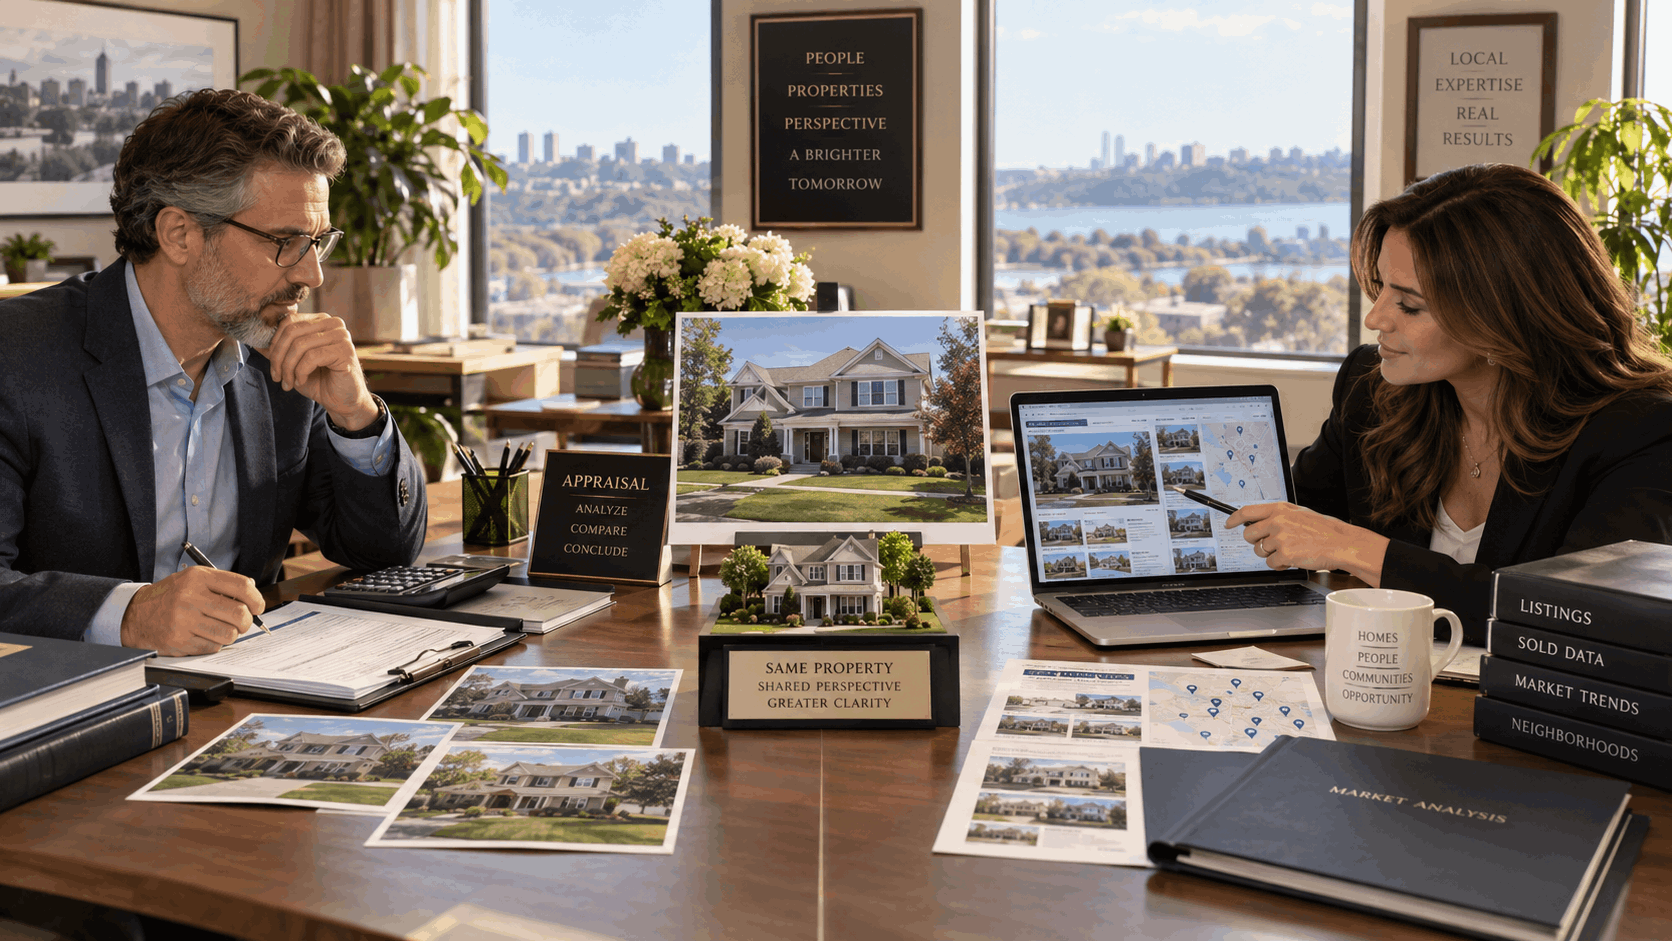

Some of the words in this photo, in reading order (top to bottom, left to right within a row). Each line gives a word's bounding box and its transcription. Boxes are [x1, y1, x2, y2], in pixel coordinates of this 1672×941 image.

[806, 52, 865, 64] PEOPLE
[1451, 52, 1508, 65] LOCAL
[788, 84, 883, 97] PROPERTIES
[1435, 78, 1523, 91] EXPERTISE
[1457, 107, 1499, 120] REAL
[785, 117, 887, 130] PERSPECTIVE
[1443, 132, 1513, 146] RESULTS
[789, 149, 800, 161] A
[805, 149, 881, 161] BRIGHTER
[788, 178, 883, 190] TOMORROW
[562, 474, 650, 491] APPRAISAL
[575, 504, 628, 516] ANALYZE
[570, 523, 628, 536] COMPARE
[563, 543, 628, 557] CONCLUDE
[1520, 598, 1592, 625] LISTINGS
[1358, 630, 1398, 643] HOMES
[1358, 652, 1398, 664] PEOPLE
[1518, 636, 1558, 656] SOLD
[1565, 646, 1605, 667] DATA
[765, 662, 808, 674] SAME
[814, 662, 893, 674] PROPERTY
[1342, 669, 1413, 684] COMMUNITIES
[758, 681, 811, 692] SHARED
[816, 681, 901, 692] PERSPECTIVE
[1342, 689, 1413, 704] OPPORTUNITY
[1515, 674, 1574, 699] MARKET
[1579, 689, 1639, 716] TRENDS
[767, 698, 828, 709] GREATER
[834, 698, 892, 709] CLARITY
[1512, 717, 1639, 762] NEIGHBORHOODS
[1329, 785, 1409, 805] MARKET
[1413, 801, 1508, 824] ANALYSIS
